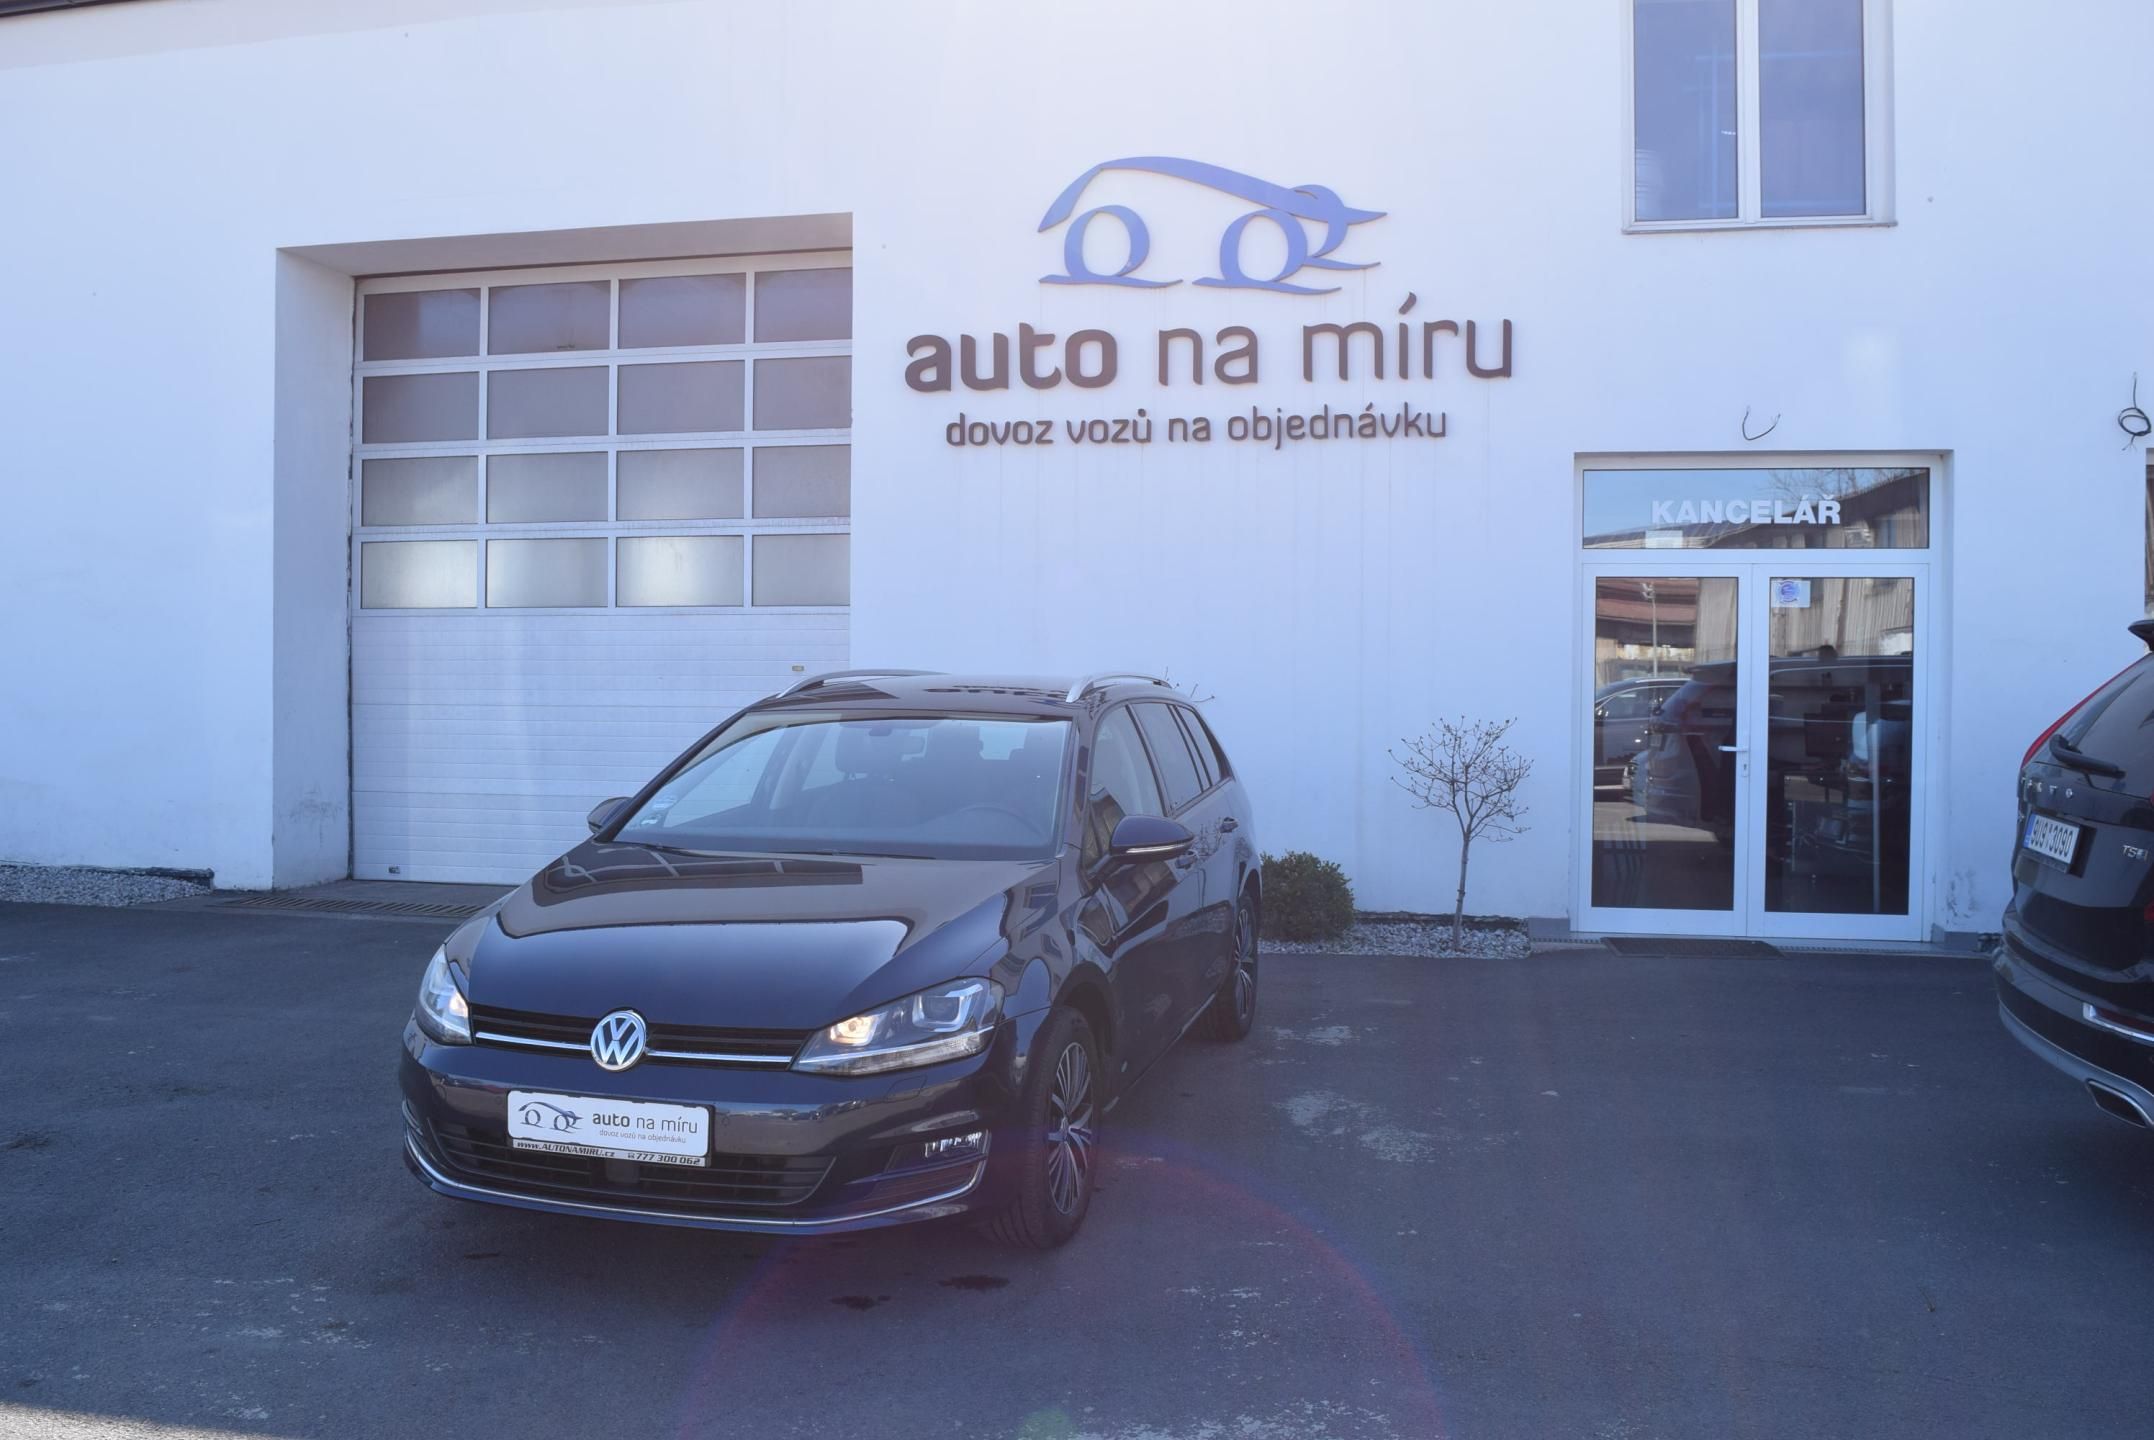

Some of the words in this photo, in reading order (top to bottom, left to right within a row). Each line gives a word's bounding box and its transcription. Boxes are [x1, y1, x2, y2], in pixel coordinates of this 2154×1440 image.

[904, 322, 1118, 393] auto
[1158, 325, 1259, 386] na
[1302, 291, 1513, 383] míru
[946, 412, 1055, 447] dovoz
[1066, 408, 1153, 444] vozů
[1168, 409, 1211, 443] na
[1227, 402, 1447, 450] objednávku
[1651, 495, 1841, 525] KANCELÁŘ
[592, 1112, 630, 1127] auto
[636, 1117, 655, 1130] na
[661, 1116, 698, 1133] míru
[599, 1128, 619, 1137] dovoz
[516, 1141, 615, 1157] www.AUTONAMIRU.cz
[636, 1152, 656, 1161] 777
[657, 1155, 678, 1164] 300
[679, 1157, 701, 1166] 062
